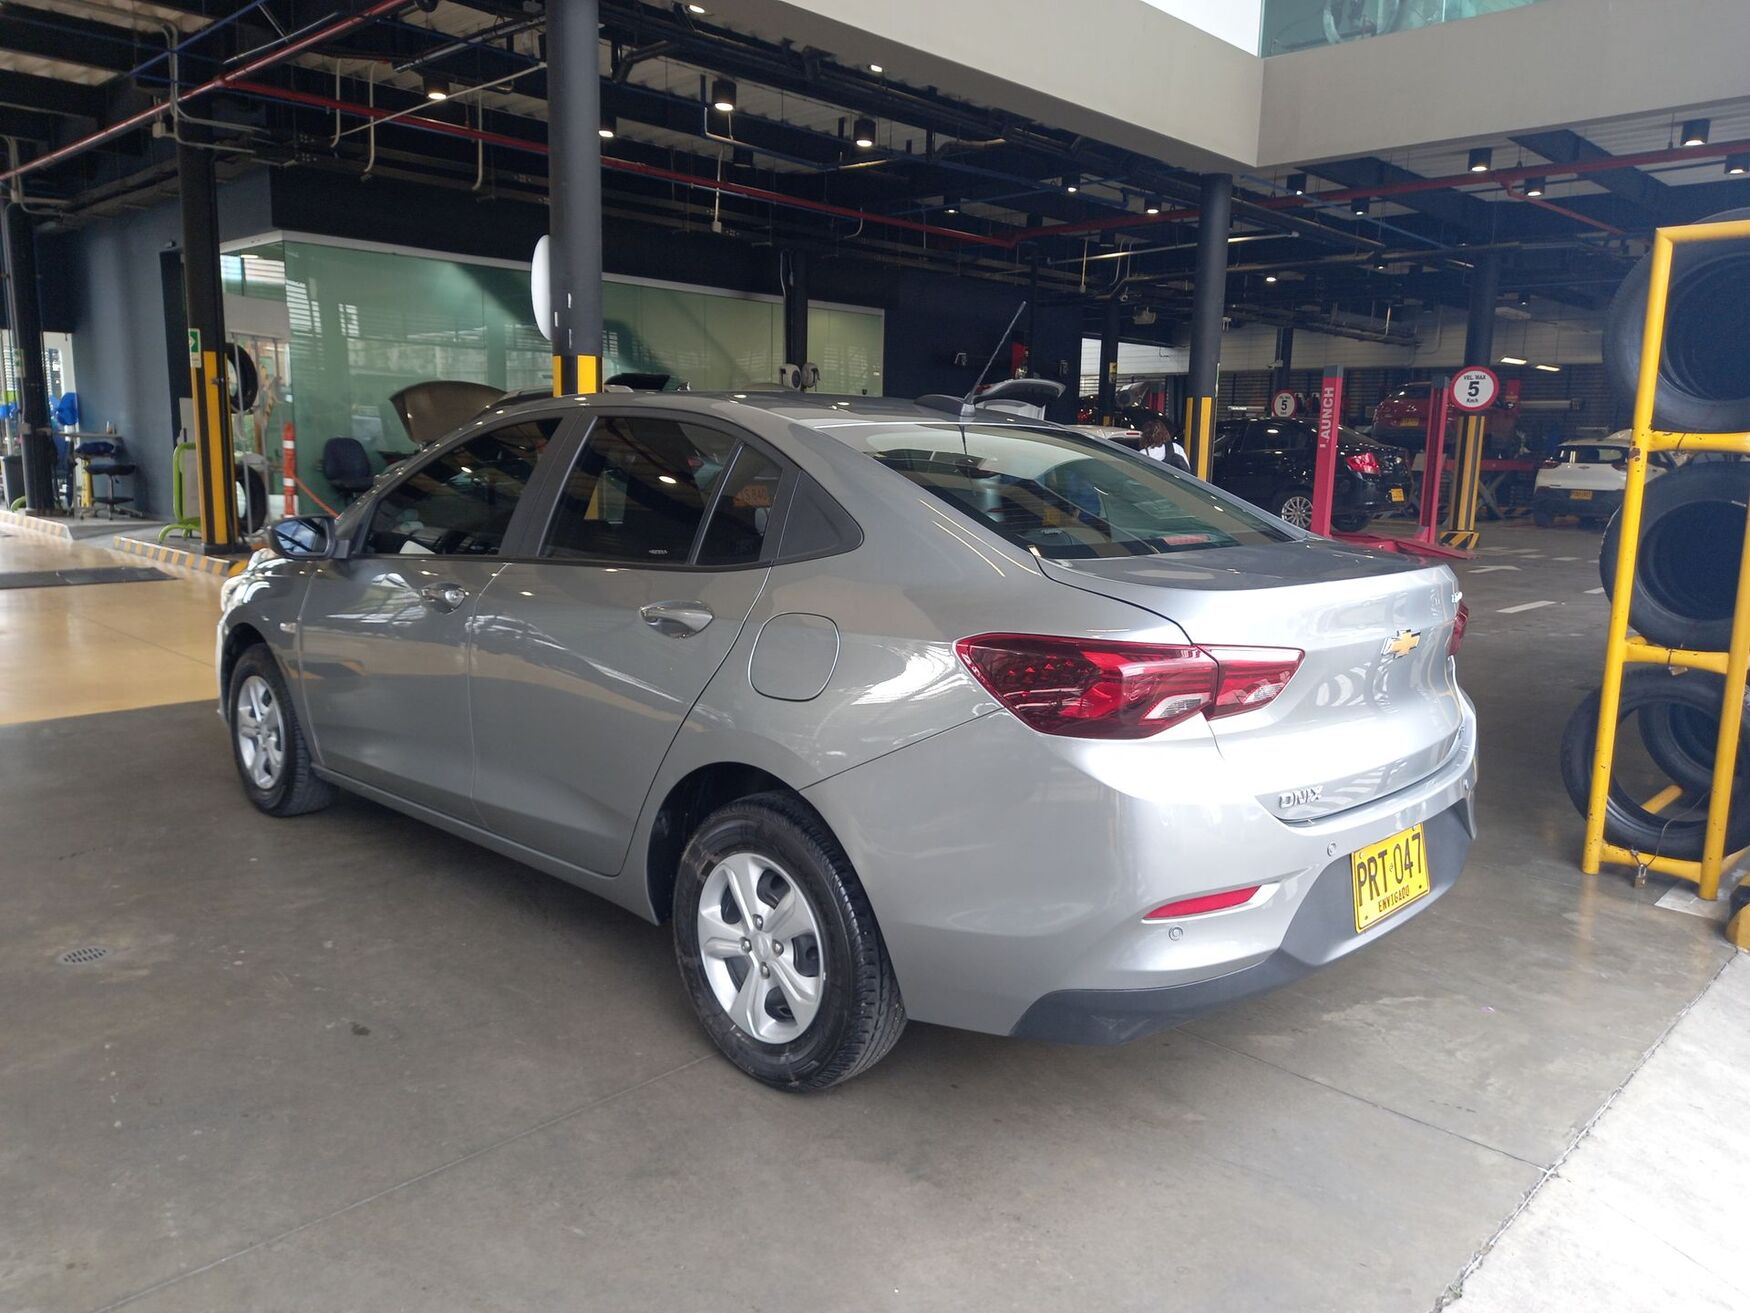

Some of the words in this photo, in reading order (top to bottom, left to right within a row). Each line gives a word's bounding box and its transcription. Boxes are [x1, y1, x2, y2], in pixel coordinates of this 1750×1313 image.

[1467, 380, 1480, 397] 5
[1281, 399, 1288, 411] 5
[1319, 387, 1334, 448] LAUNCH
[1356, 849, 1388, 907] PRT
[1393, 832, 1421, 884] 047
[1378, 885, 1410, 913] ENVIGADO
